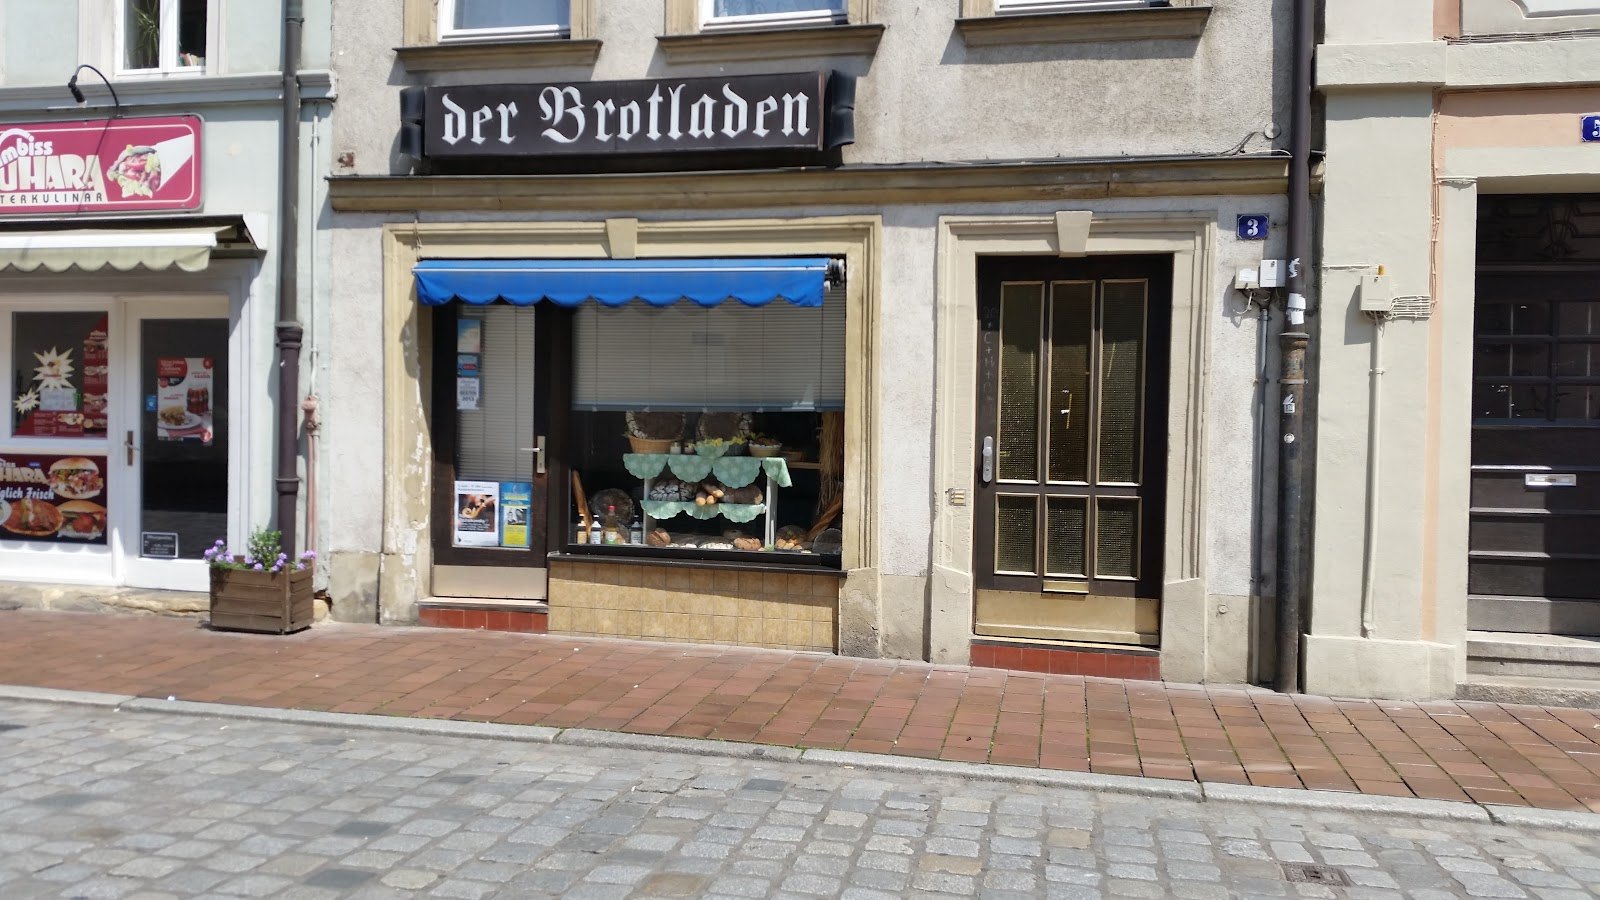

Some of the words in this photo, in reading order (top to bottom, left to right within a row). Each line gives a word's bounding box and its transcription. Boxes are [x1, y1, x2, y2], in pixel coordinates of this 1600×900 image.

[441, 92, 519, 146] der
[537, 82, 811, 144] Brotladen
[1247, 219, 1259, 236] 3
